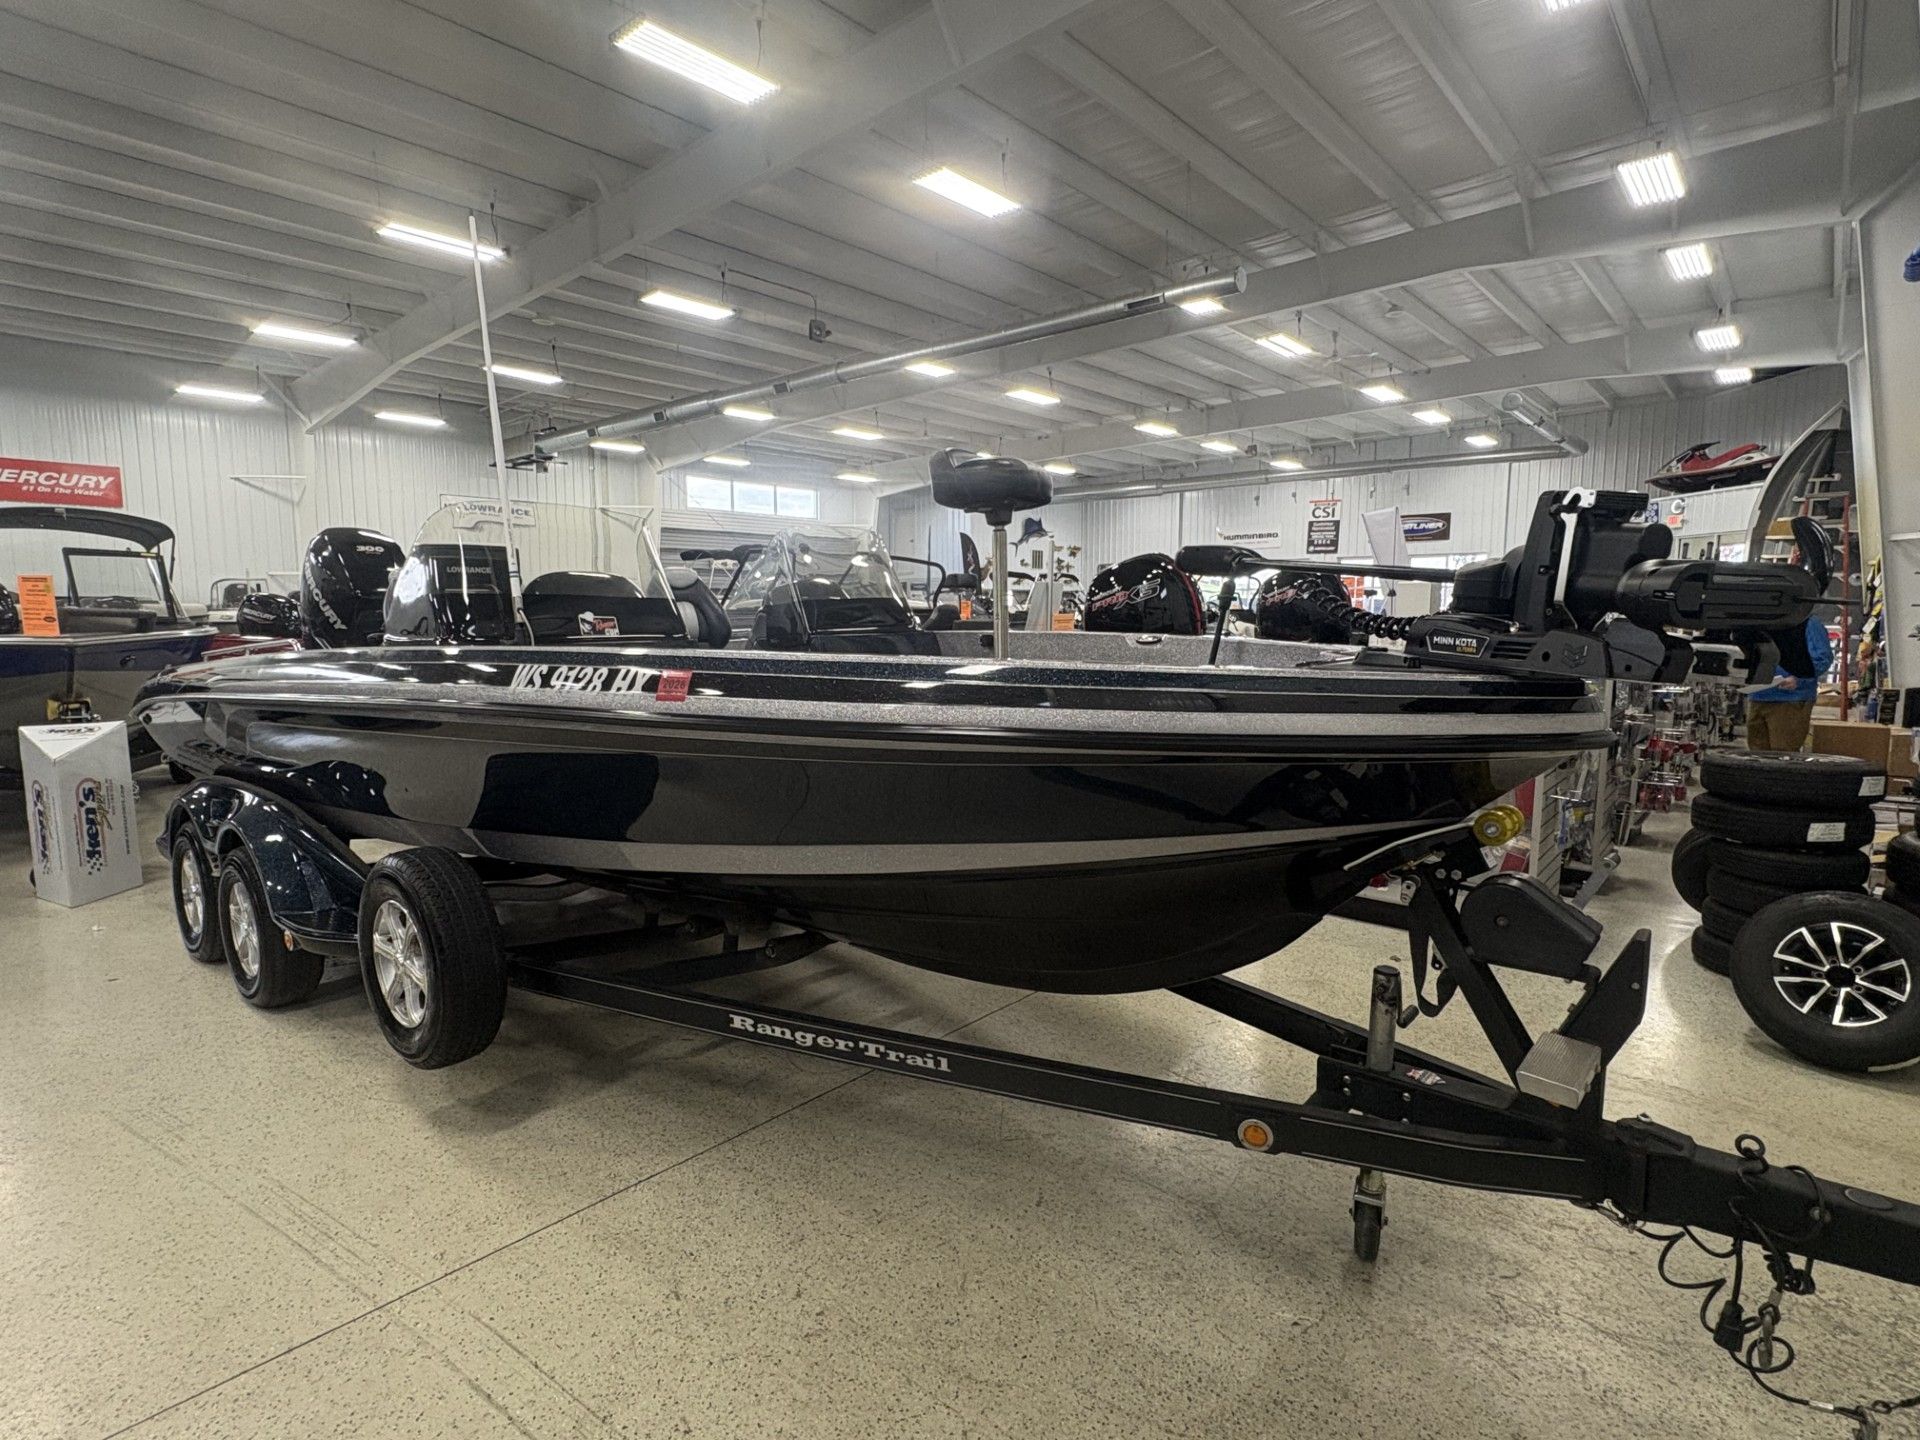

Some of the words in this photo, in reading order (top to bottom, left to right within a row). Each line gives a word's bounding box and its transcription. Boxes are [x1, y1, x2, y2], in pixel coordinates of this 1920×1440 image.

[0, 468, 114, 489] ERCURY
[1311, 507, 1336, 519] CSI
[1223, 532, 1279, 541] HUMMINBIRD
[356, 545, 385, 553] 300
[1432, 636, 1455, 646] MINN
[1455, 638, 1477, 648] KOTA
[510, 664, 549, 690] WS
[729, 1014, 855, 1051] Ranger
[858, 1041, 951, 1073] Trail
